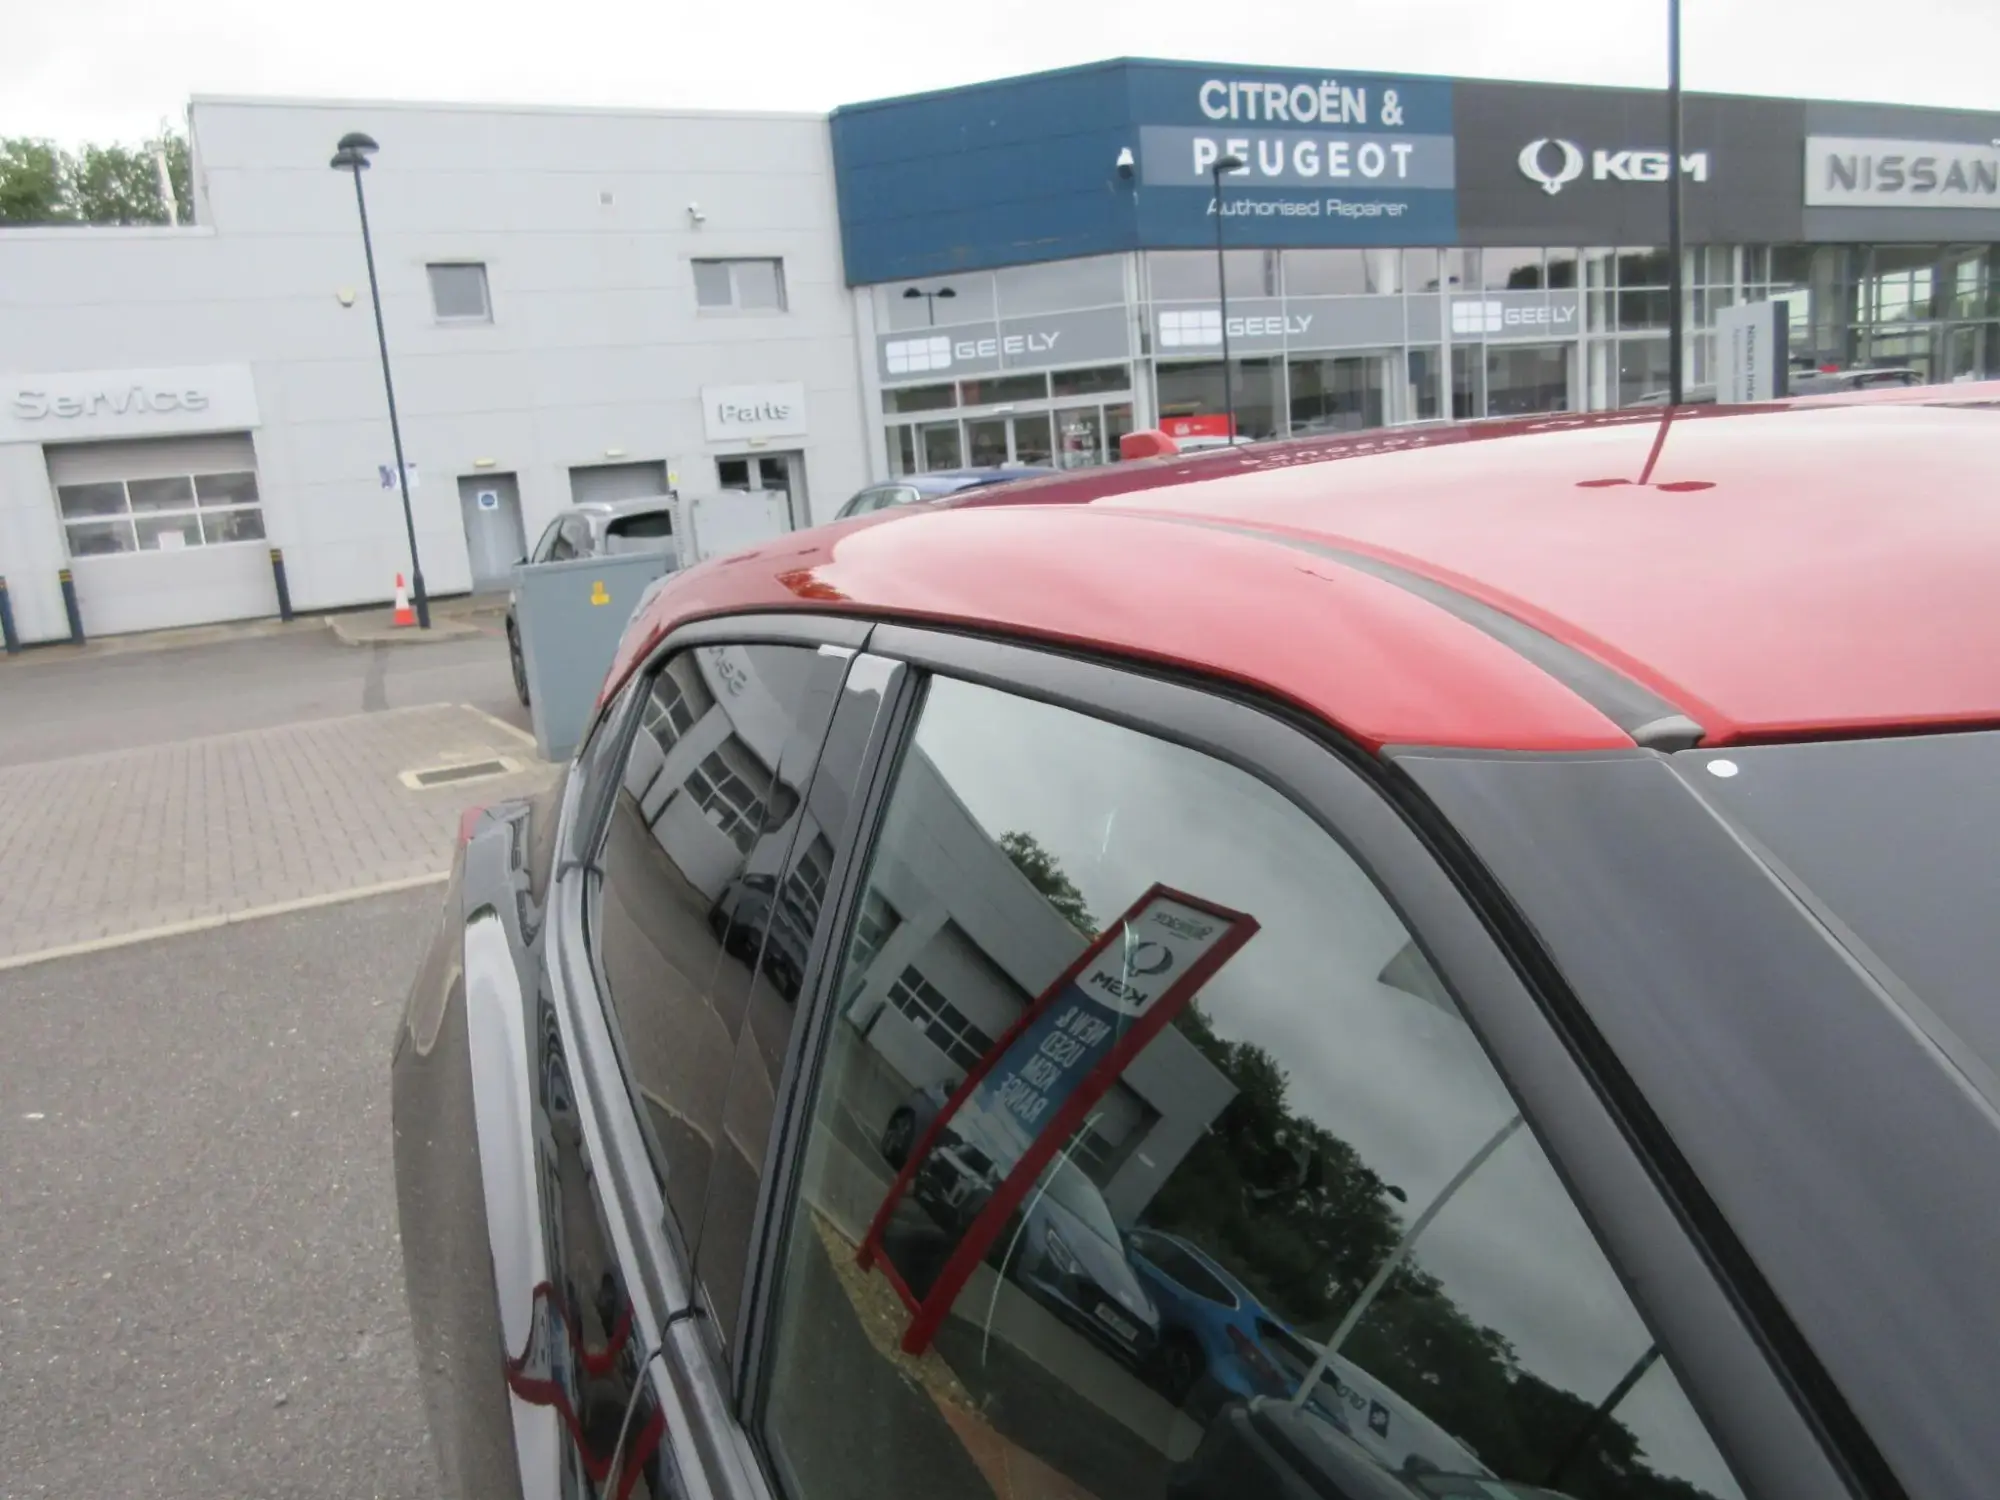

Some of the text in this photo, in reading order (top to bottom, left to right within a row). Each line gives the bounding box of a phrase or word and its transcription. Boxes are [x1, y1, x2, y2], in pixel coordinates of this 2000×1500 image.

[1199, 80, 1404, 126] CITROËN &
[1193, 138, 1413, 179] PEUGEOT
[1592, 150, 1707, 182] KGM
[1826, 153, 1998, 194] NISSAN
[1206, 198, 1409, 219] Authorised Repairer
[1225, 314, 1313, 338] GEELY
[1504, 305, 1577, 325] GEELY
[954, 331, 1060, 360] GEELY
[14, 385, 210, 420] Service
[717, 402, 791, 424] Parts
